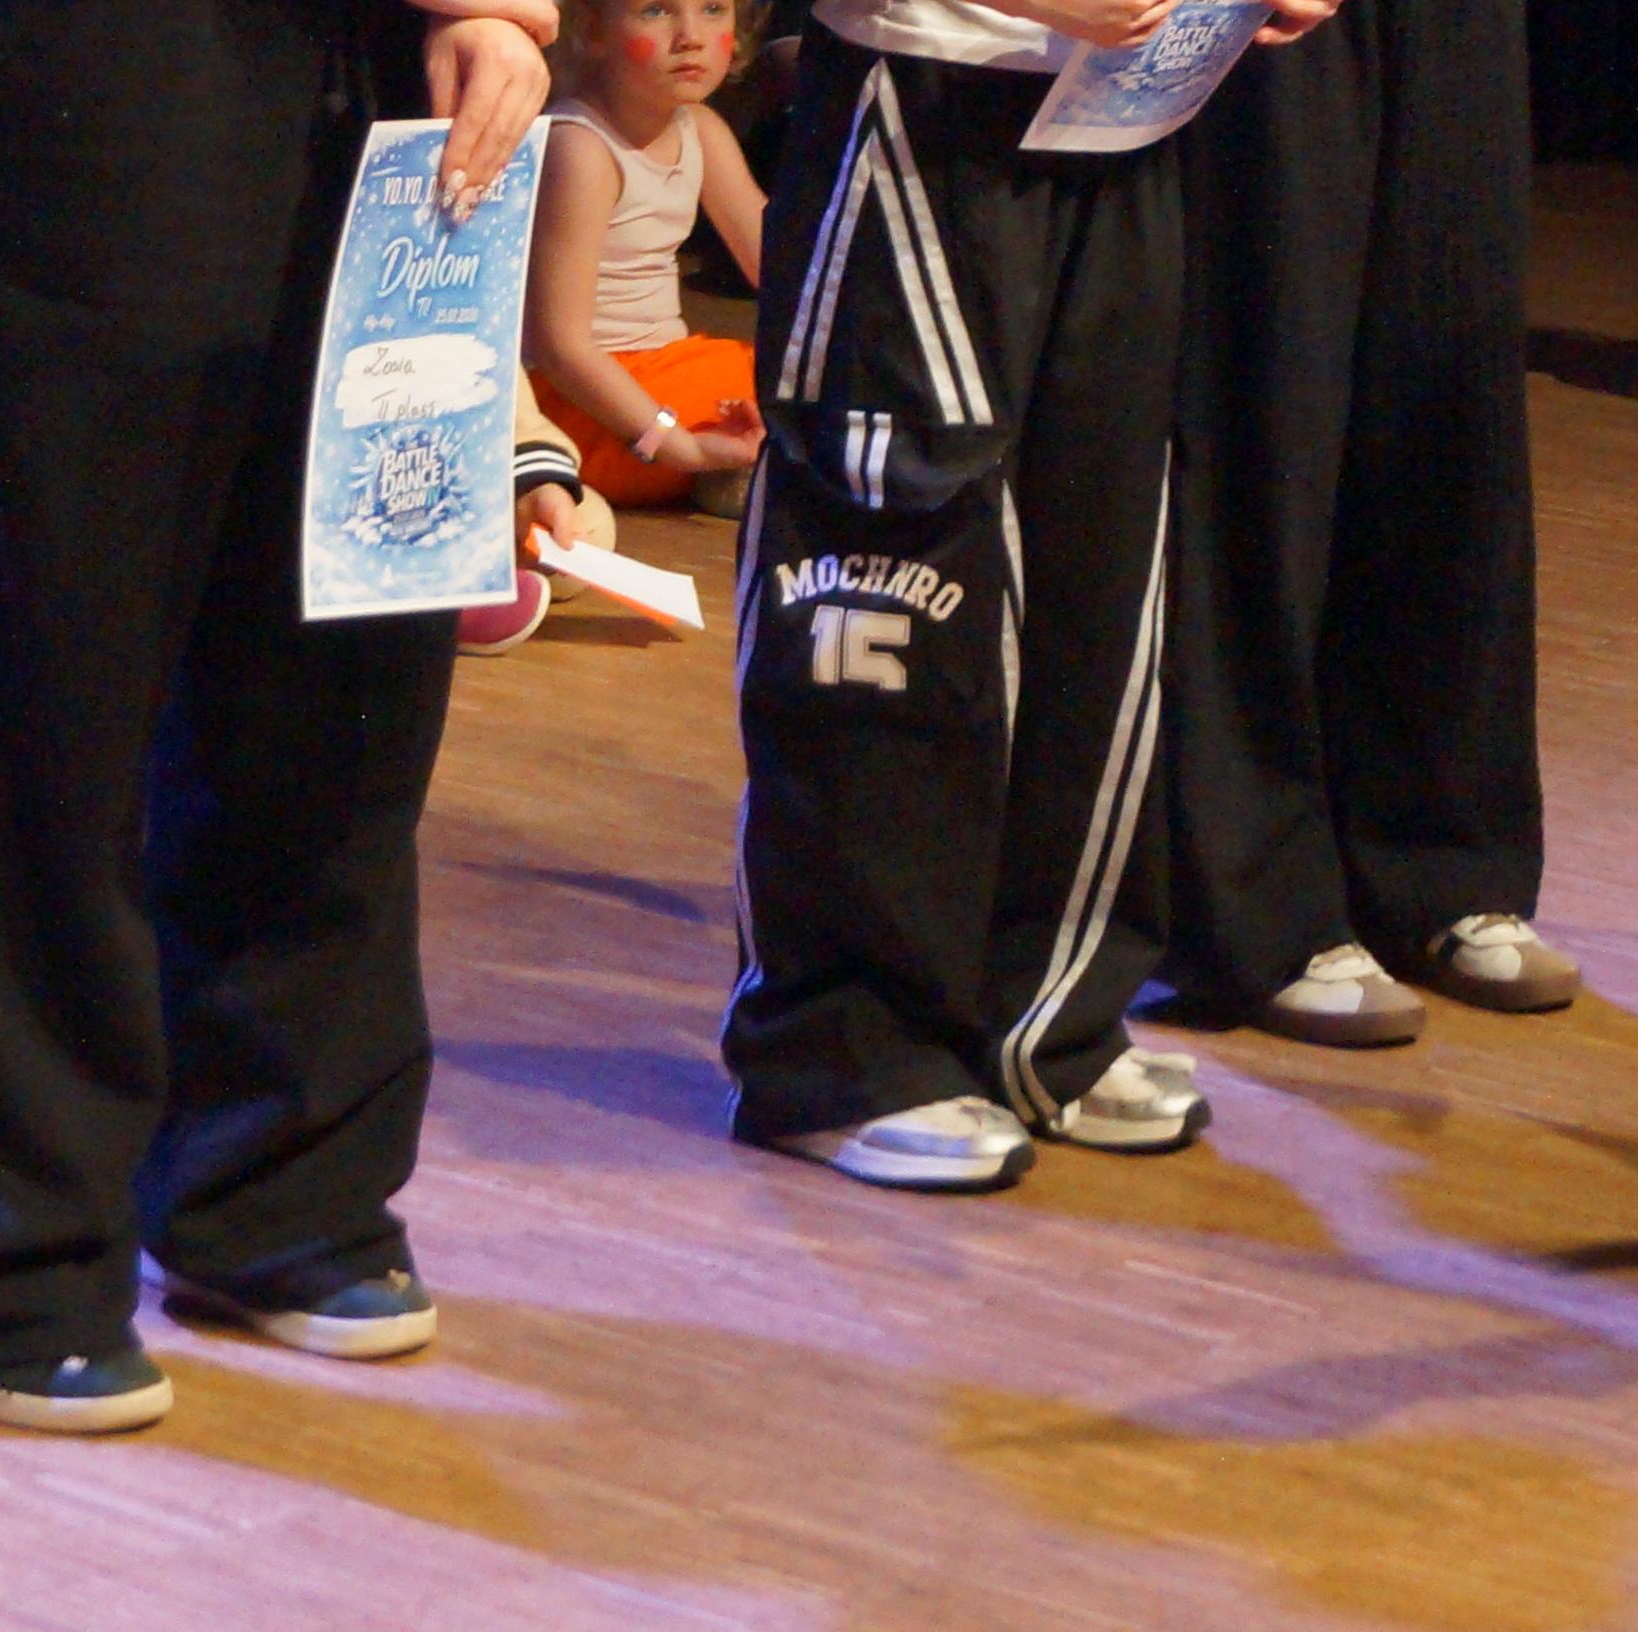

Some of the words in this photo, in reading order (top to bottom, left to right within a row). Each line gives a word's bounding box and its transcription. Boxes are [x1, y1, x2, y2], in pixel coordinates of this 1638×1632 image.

[377, 232, 482, 313] Diplom
[380, 464, 442, 500] DANCE
[382, 444, 440, 474] BATTLE
[811, 604, 912, 692] 15
